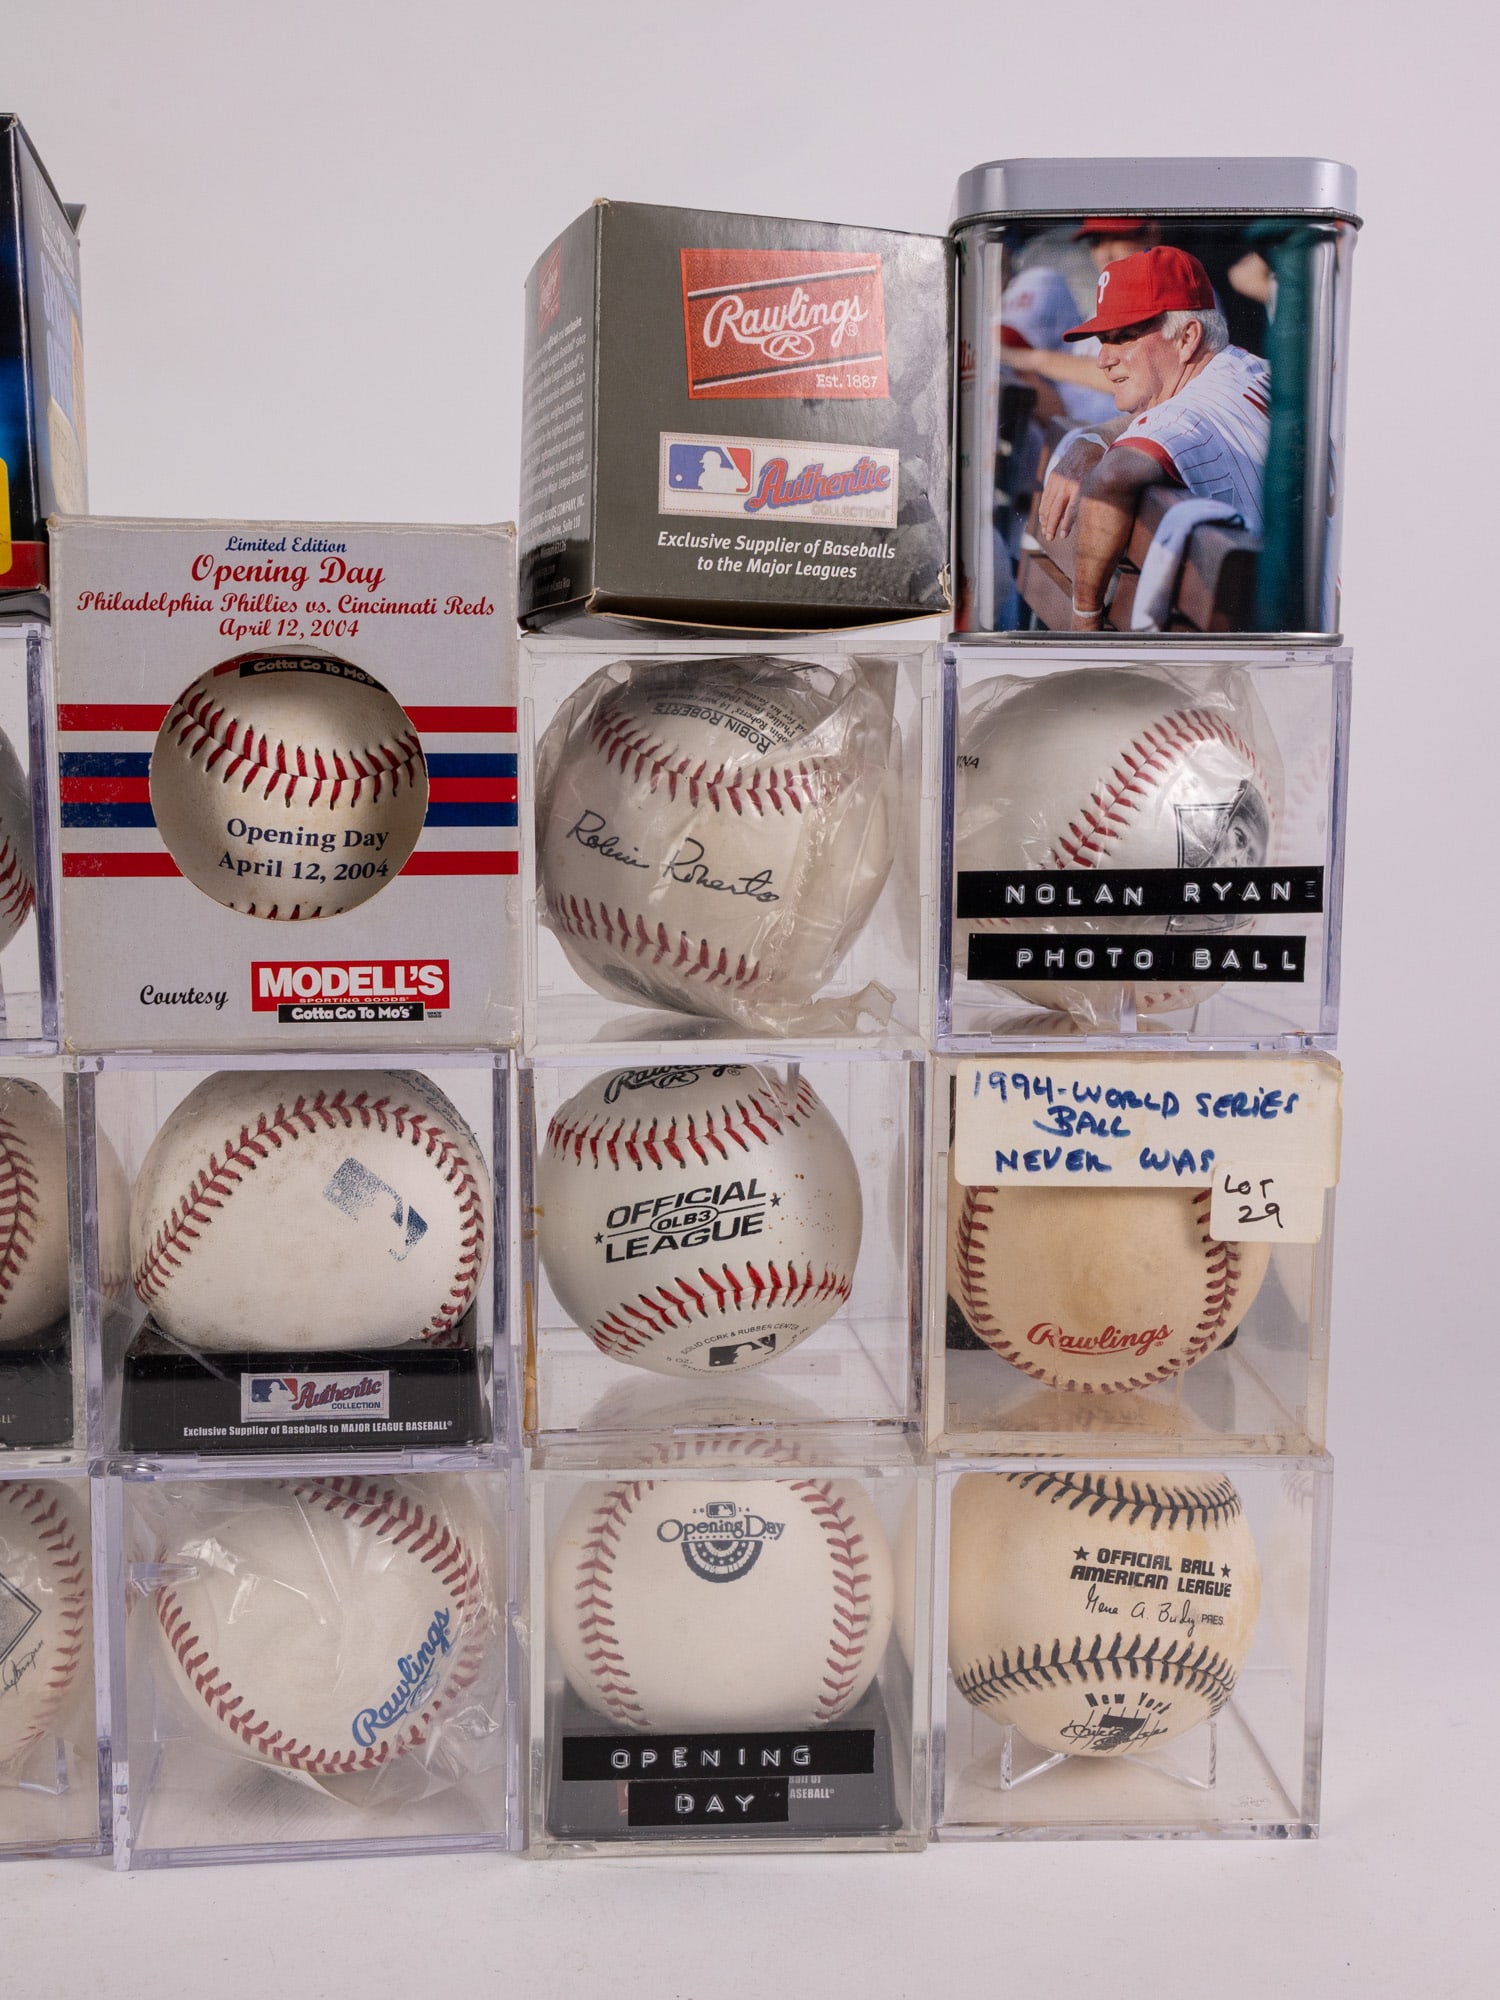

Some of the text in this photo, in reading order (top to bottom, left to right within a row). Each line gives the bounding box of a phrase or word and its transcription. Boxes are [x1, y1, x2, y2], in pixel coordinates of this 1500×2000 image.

[703, 287, 868, 348] Rawlings
[816, 373, 878, 388] Est. 1887
[744, 456, 891, 513] Authentic
[225, 535, 348, 553] Limited Edition
[658, 531, 896, 559] Exclusive Supplier of Baseballs
[191, 554, 386, 593] Opening Day
[697, 556, 857, 580] to the Major Leagues
[76, 591, 495, 617] Philadelphia Phillies vs. Cincinnati Reds
[219, 618, 360, 641] April 12, 2004
[253, 658, 298, 673] Gotta
[300, 658, 322, 671] Go
[323, 661, 341, 674] To
[724, 718, 771, 755] ROBIN
[766, 711, 796, 738] Phillies
[769, 726, 789, 743] obin
[227, 818, 390, 852] Opening Day
[218, 851, 389, 883] April 12, 2004
[567, 809, 780, 902] Robin Roberts
[1005, 881, 1292, 906] NOLAN RYAN
[1016, 948, 1297, 970] PHOTO BALL
[258, 964, 445, 998] MODELL'S
[140, 984, 229, 1011] Courtesy
[291, 1006, 411, 1020] Gotta Go To Mo's
[1033, 1105, 1131, 1137] BALL
[995, 1146, 1112, 1173] NEVER
[606, 1178, 766, 1229] OFFICIAL
[1238, 1202, 1284, 1229] 29
[657, 1210, 711, 1231] OLB3
[606, 1212, 765, 1263] LEAGUE
[1027, 1322, 1174, 1356] Rawlings
[291, 1376, 383, 1410] Authentic
[331, 1401, 381, 1410] COLLECTION
[183, 1426, 227, 1437] Exclusive
[229, 1425, 269, 1436] Supplier
[270, 1425, 280, 1435] of
[282, 1424, 327, 1435] Baseballs
[329, 1424, 339, 1433] to
[341, 1422, 370, 1433] MAJOR
[372, 1421, 404, 1432] LEAGUE
[657, 1514, 786, 1543] Opening Day
[1097, 1547, 1216, 1577] OFFICIAL BALL
[1070, 1565, 1233, 1598] AMERICAN LEAGUE
[1201, 1613, 1226, 1626] PRES.
[352, 1607, 450, 1747] Rawlings
[611, 1745, 811, 1769] OPENING
[675, 1793, 755, 1814] DAY
